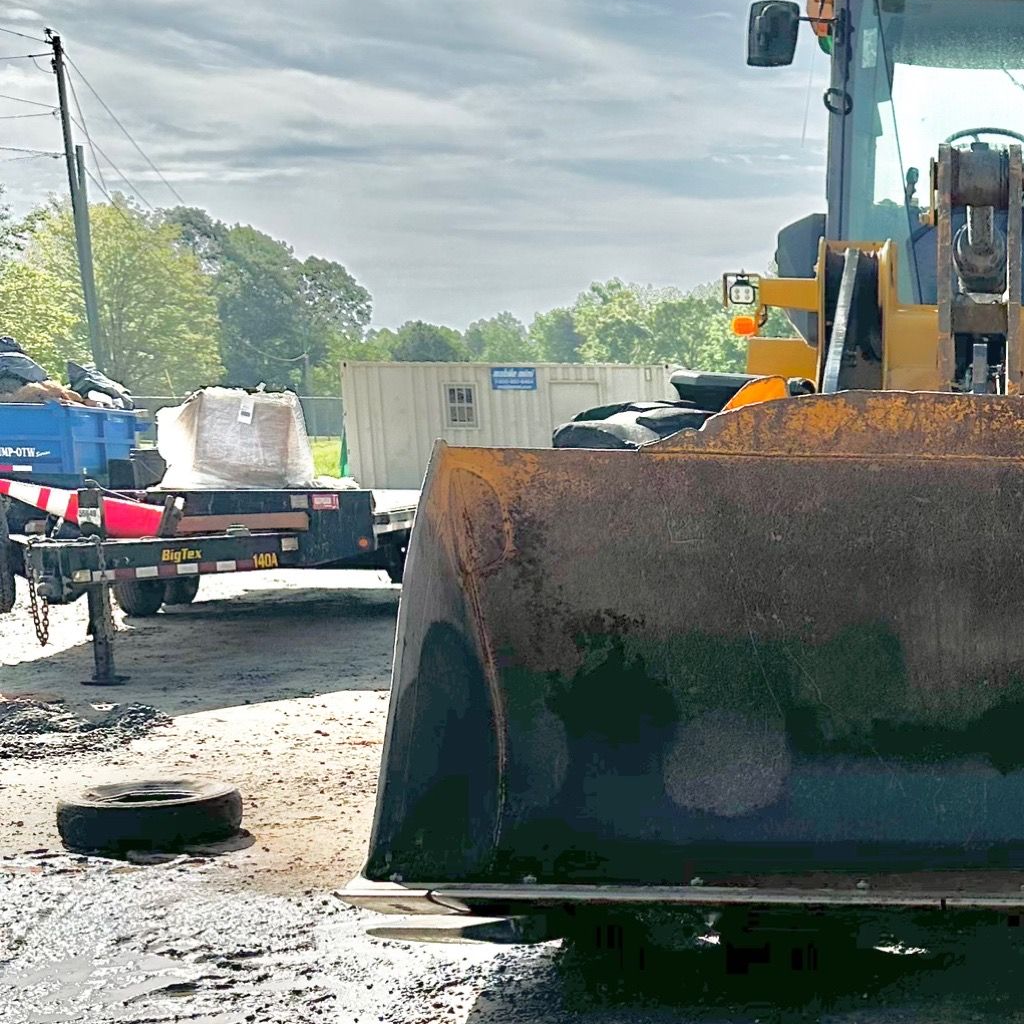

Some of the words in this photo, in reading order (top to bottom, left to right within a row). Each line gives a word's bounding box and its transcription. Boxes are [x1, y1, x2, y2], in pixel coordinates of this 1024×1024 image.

[0, 447, 35, 457] MP-OTW
[162, 549, 202, 563] BigTex
[252, 552, 278, 568] 140A
